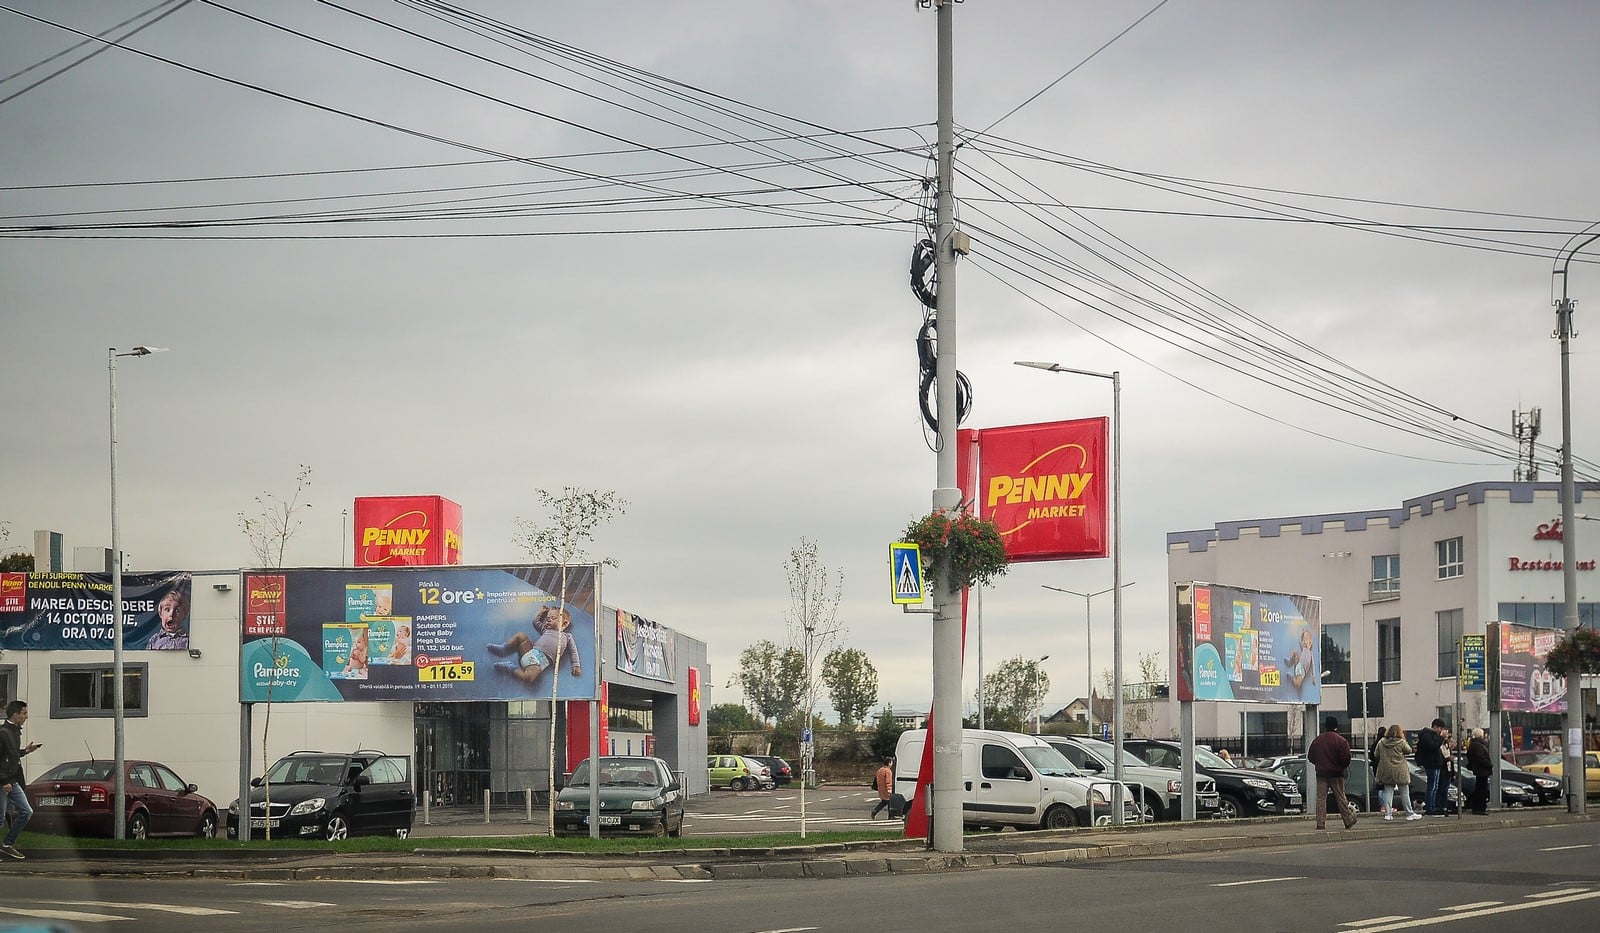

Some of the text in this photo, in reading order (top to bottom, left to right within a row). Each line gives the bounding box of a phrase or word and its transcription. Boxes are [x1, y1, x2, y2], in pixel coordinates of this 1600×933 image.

[987, 472, 1094, 508] PENNY
[1028, 504, 1086, 519] MARKET
[362, 527, 431, 547] PENNY
[390, 548, 426, 556] MARKET
[1508, 557, 1596, 571] Restaunt
[251, 590, 282, 598] PENNY
[419, 588, 474, 604] 12 ore
[31, 598, 154, 612] MAREA DESCHDERE
[46, 613, 138, 627] 14 OCTOMBIE,
[1268, 612, 1279, 623] ore
[62, 628, 114, 639] ORA 07.0
[254, 662, 300, 679] Pampers
